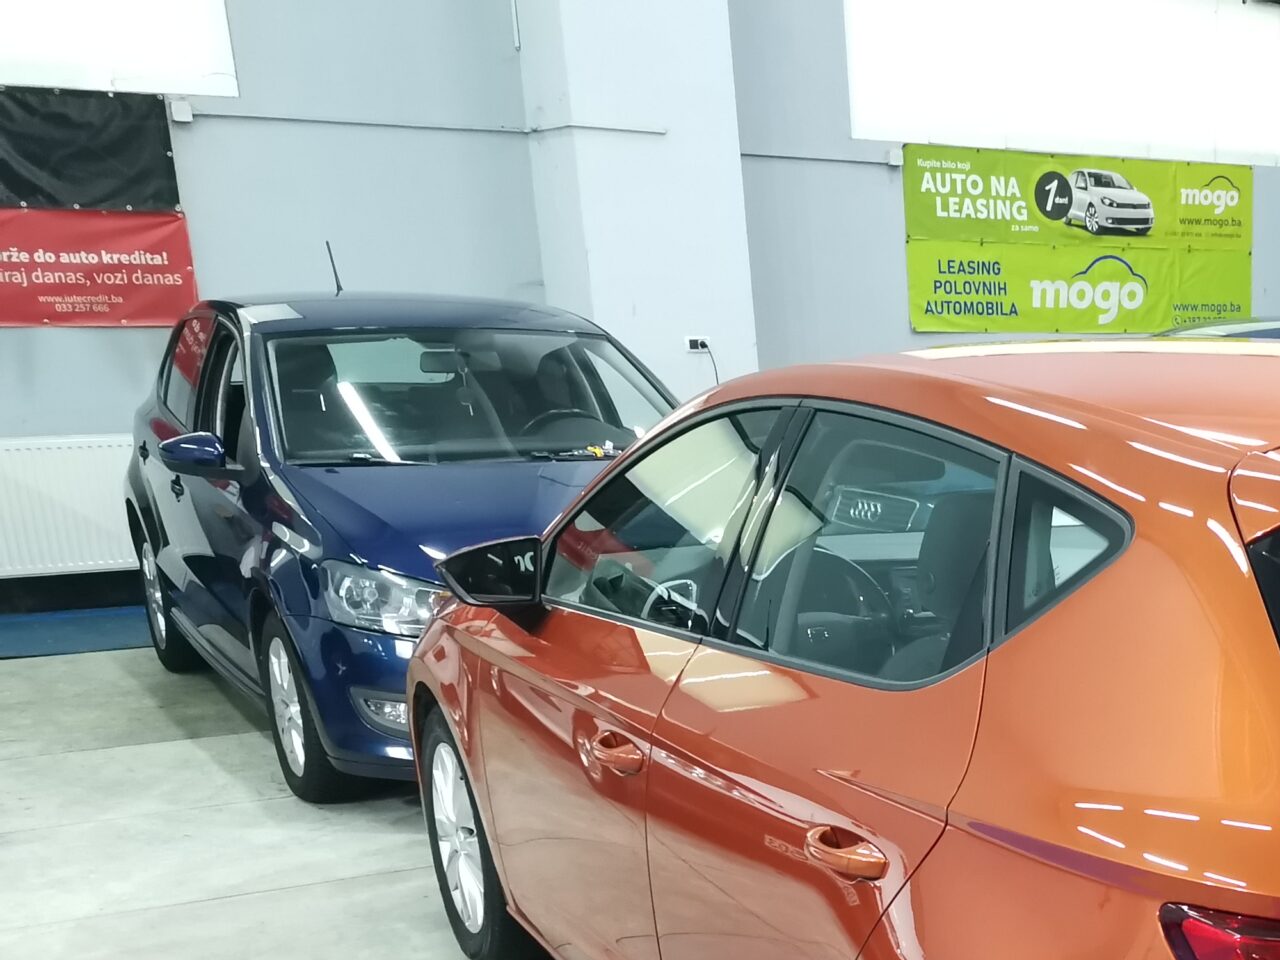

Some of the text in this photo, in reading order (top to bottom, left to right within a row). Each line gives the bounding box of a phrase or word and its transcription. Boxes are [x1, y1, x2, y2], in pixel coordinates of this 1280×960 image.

[921, 172, 1021, 198] AUTO NA
[936, 196, 1028, 222] LEASING
[1180, 188, 1240, 215] mogo
[1179, 217, 1242, 229] www.mogo.ba
[0, 247, 169, 265] rže do auto kredita!
[938, 259, 1002, 276] LEASING
[32, 267, 91, 287] danas,
[93, 269, 128, 285] vozi
[132, 269, 183, 285] danas
[933, 280, 1008, 296] POLOVNIH
[924, 301, 1019, 316] AUTOMOBILA
[1029, 279, 1145, 325] mogo
[1172, 302, 1242, 315] www.mogo.ba
